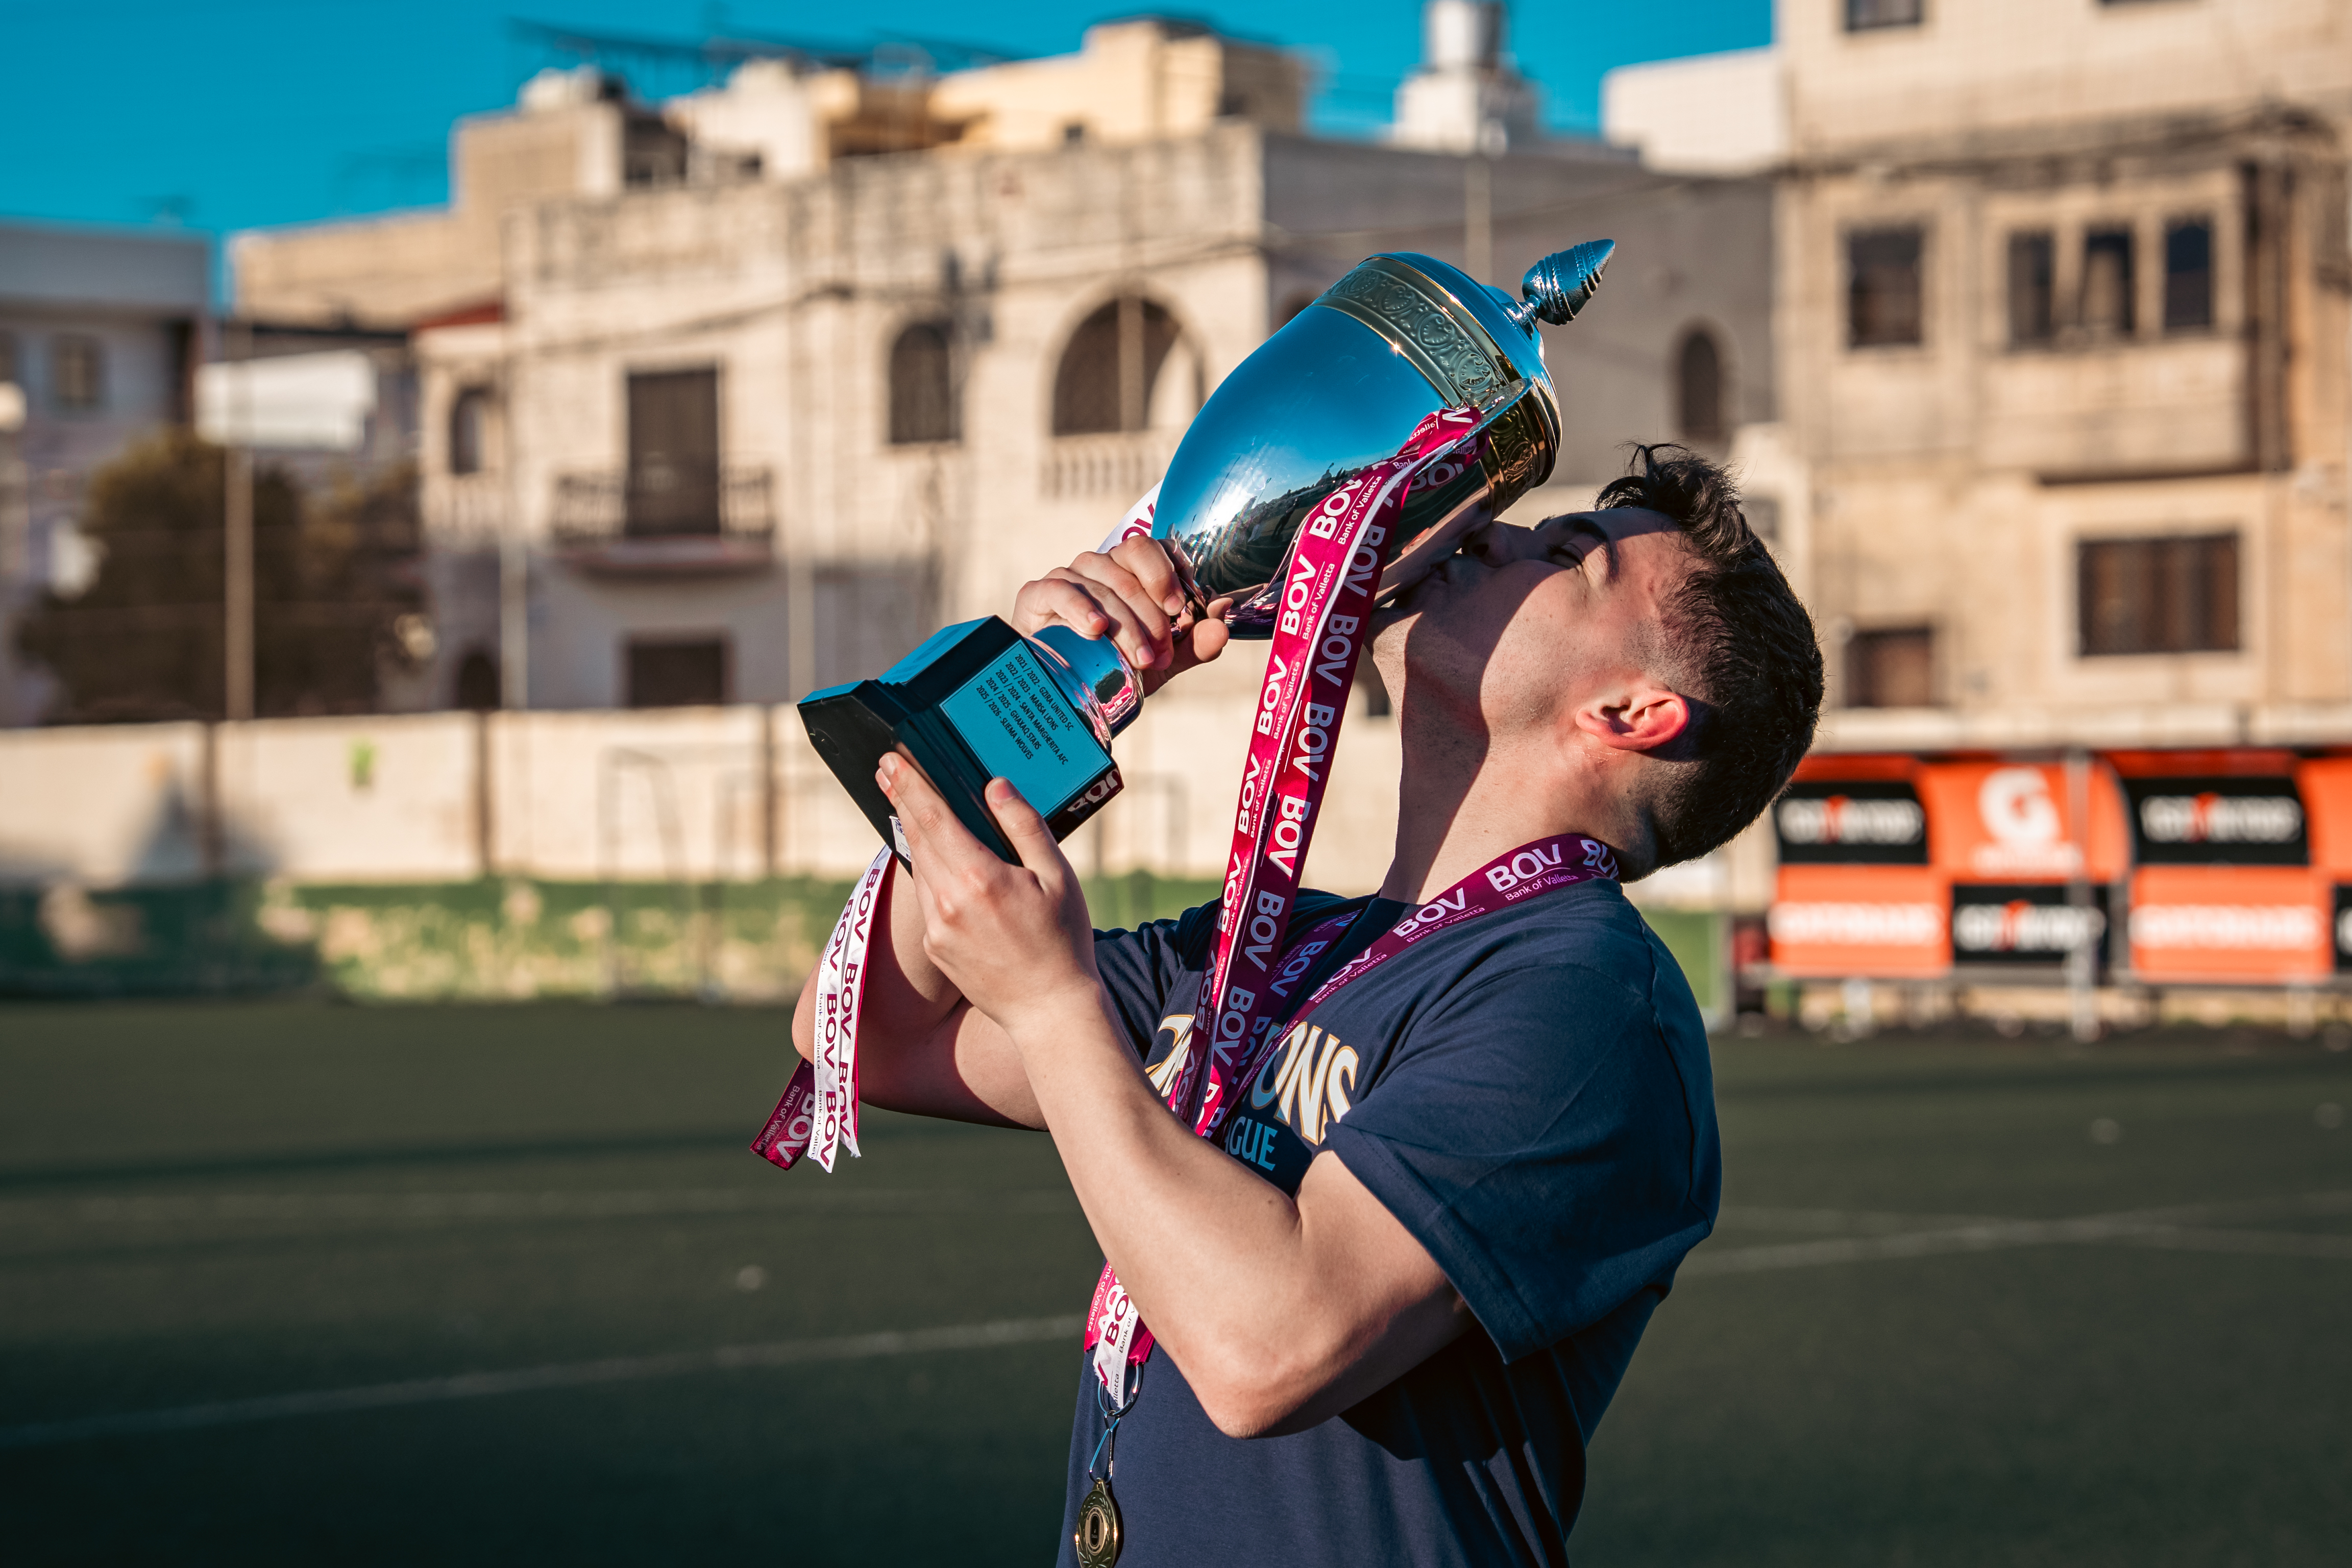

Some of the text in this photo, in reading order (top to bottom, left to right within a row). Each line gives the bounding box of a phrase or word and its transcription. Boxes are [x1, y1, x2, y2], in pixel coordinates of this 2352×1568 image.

[1309, 478, 1363, 540] BOV
[1338, 476, 1382, 545] Bank of Valletta
[1281, 554, 1317, 636] BOV
[1344, 525, 1386, 597] BOV
[1303, 563, 1335, 640] Bank of Valletta
[1316, 613, 1359, 687] BOV
[976, 685, 990, 700] 2025
[989, 702, 1002, 717] 2026
[1000, 718, 1018, 739] SLIEMA
[1015, 737, 1034, 760] WOLVES
[986, 677, 999, 692] 2024
[998, 694, 1011, 708] 2025
[1011, 710, 1030, 736] GHAXAQ
[1026, 732, 1042, 750] STARS
[996, 670, 1009, 684] 2023
[1008, 686, 1021, 701] 2024
[1020, 702, 1035, 721] SANTA
[1033, 719, 1060, 755] MARGHERITA
[1057, 753, 1068, 765] AFC
[1006, 662, 1018, 676] 2022
[1018, 678, 1031, 693] 2023
[1030, 694, 1046, 715] MARSA
[1043, 713, 1059, 730] LIONS
[1015, 654, 1027, 669] 2021
[1027, 671, 1040, 685] 2022
[1039, 687, 1054, 705] GZIRA
[1051, 702, 1068, 723] UNITED
[1065, 722, 1074, 731] SC
[1257, 654, 1287, 736] BOV
[1273, 662, 1300, 740] Bank of Valletta
[1293, 702, 1335, 782] BOV
[1238, 752, 1261, 835] BOV
[1255, 799, 1261, 813] of
[1257, 760, 1271, 798] Valletta
[1269, 795, 1311, 878] BOV
[1485, 844, 1562, 892] BOV
[854, 868, 880, 943] BOV
[1217, 852, 1241, 933] BOV
[1227, 858, 1249, 937] Bank of Valletta
[1392, 888, 1466, 938] BOV
[1505, 872, 1579, 901] Bank of Valletta
[829, 899, 854, 972] BOV
[1244, 890, 1285, 972] BOV
[1406, 906, 1485, 943] Bank of Valletta
[841, 963, 859, 1040] BOV
[1196, 950, 1217, 1031] BOV
[1212, 957, 1226, 995] Valletta
[1270, 940, 1329, 997] BOV
[1315, 954, 1388, 1003] Bank of Valletta
[824, 994, 837, 1069] BOV
[1214, 986, 1255, 1067] BOV
[756, 1085, 800, 1152] Bank of Valletta
[776, 1092, 815, 1163] BOV
[820, 1091, 837, 1167] BOV
[1088, 1294, 1102, 1332] Valletta
[1099, 1281, 1106, 1293] of
[1105, 1294, 1129, 1347] BO
[1118, 1317, 1133, 1354] Bank of
